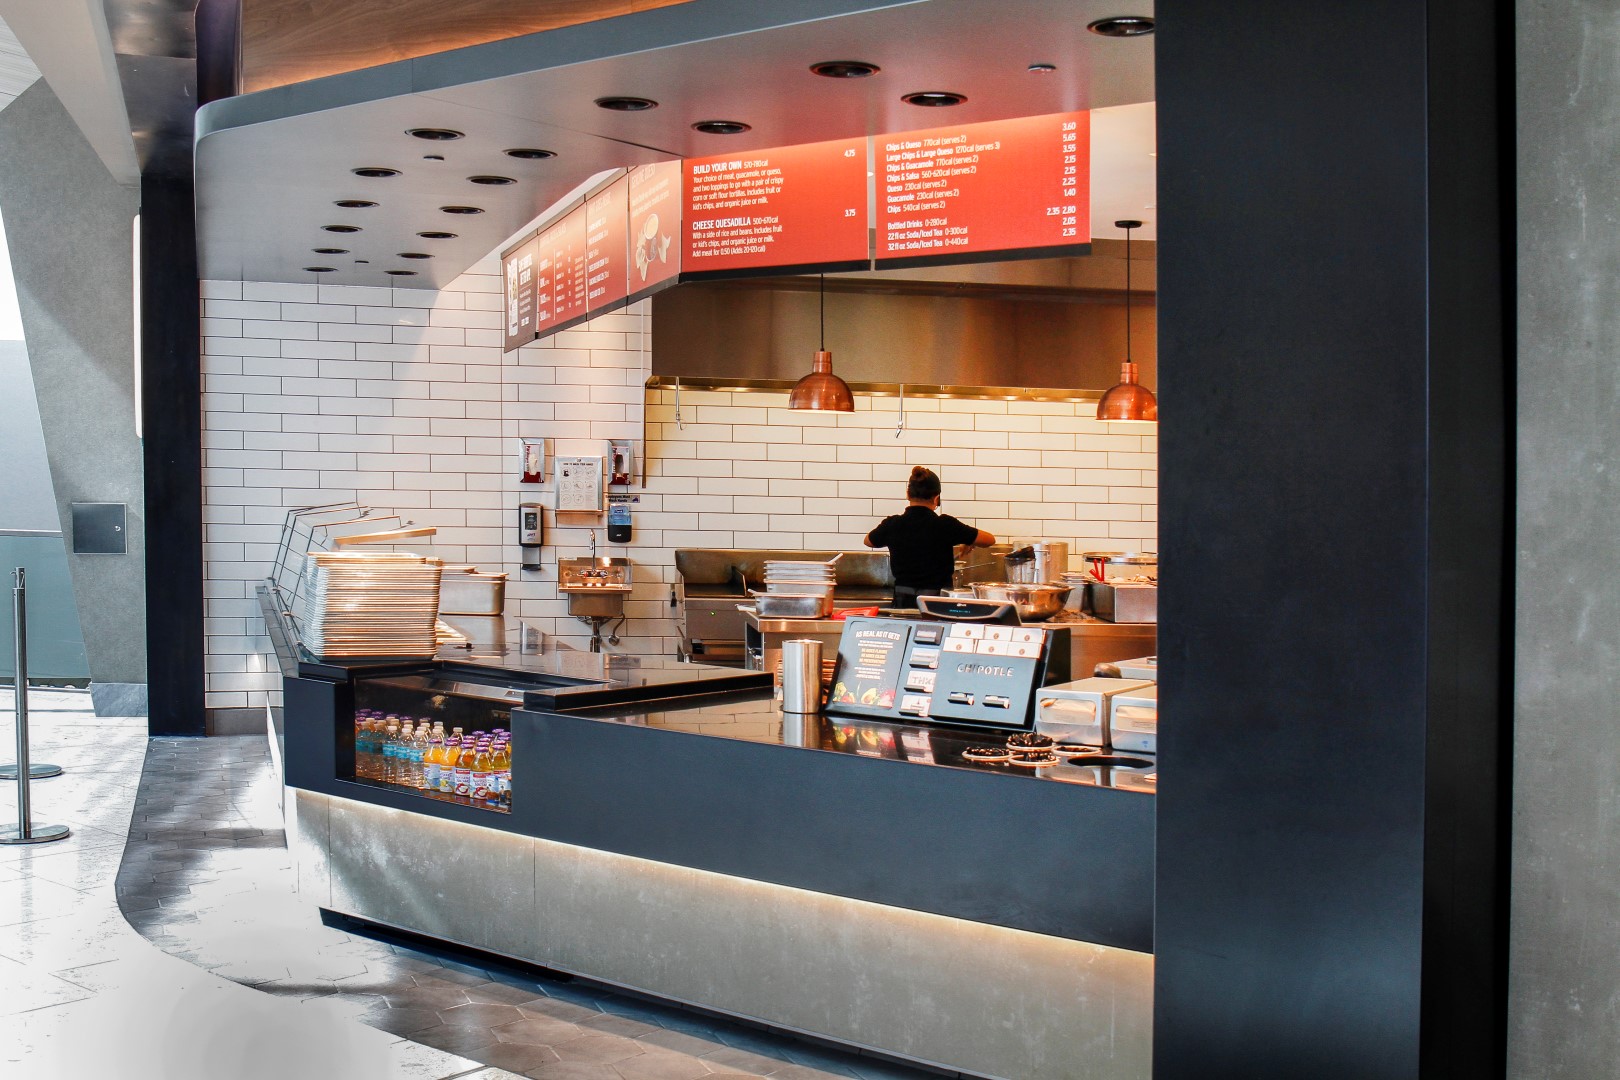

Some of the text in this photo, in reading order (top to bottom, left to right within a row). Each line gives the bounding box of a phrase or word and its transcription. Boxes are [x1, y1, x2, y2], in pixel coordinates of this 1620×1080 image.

[1062, 122, 1076, 131] 3.60
[1063, 133, 1076, 142] 5.65
[1063, 144, 1076, 153] 3.55
[1065, 155, 1076, 163] 2.15
[694, 165, 710, 174] BUILD
[712, 163, 727, 172] YOUR
[729, 161, 742, 170] OWN
[1062, 177, 1076, 185] 2.25
[1064, 188, 1076, 196] 1.40
[1047, 206, 1076, 215] 2.35 2.80
[693, 220, 714, 230] CHEESE
[716, 217, 751, 228] QUESADILLA
[1063, 217, 1076, 225] 2.05
[1063, 228, 1076, 236] 2.35
[888, 632, 900, 640] GETS
[957, 663, 1014, 676] CHIPOTLE
